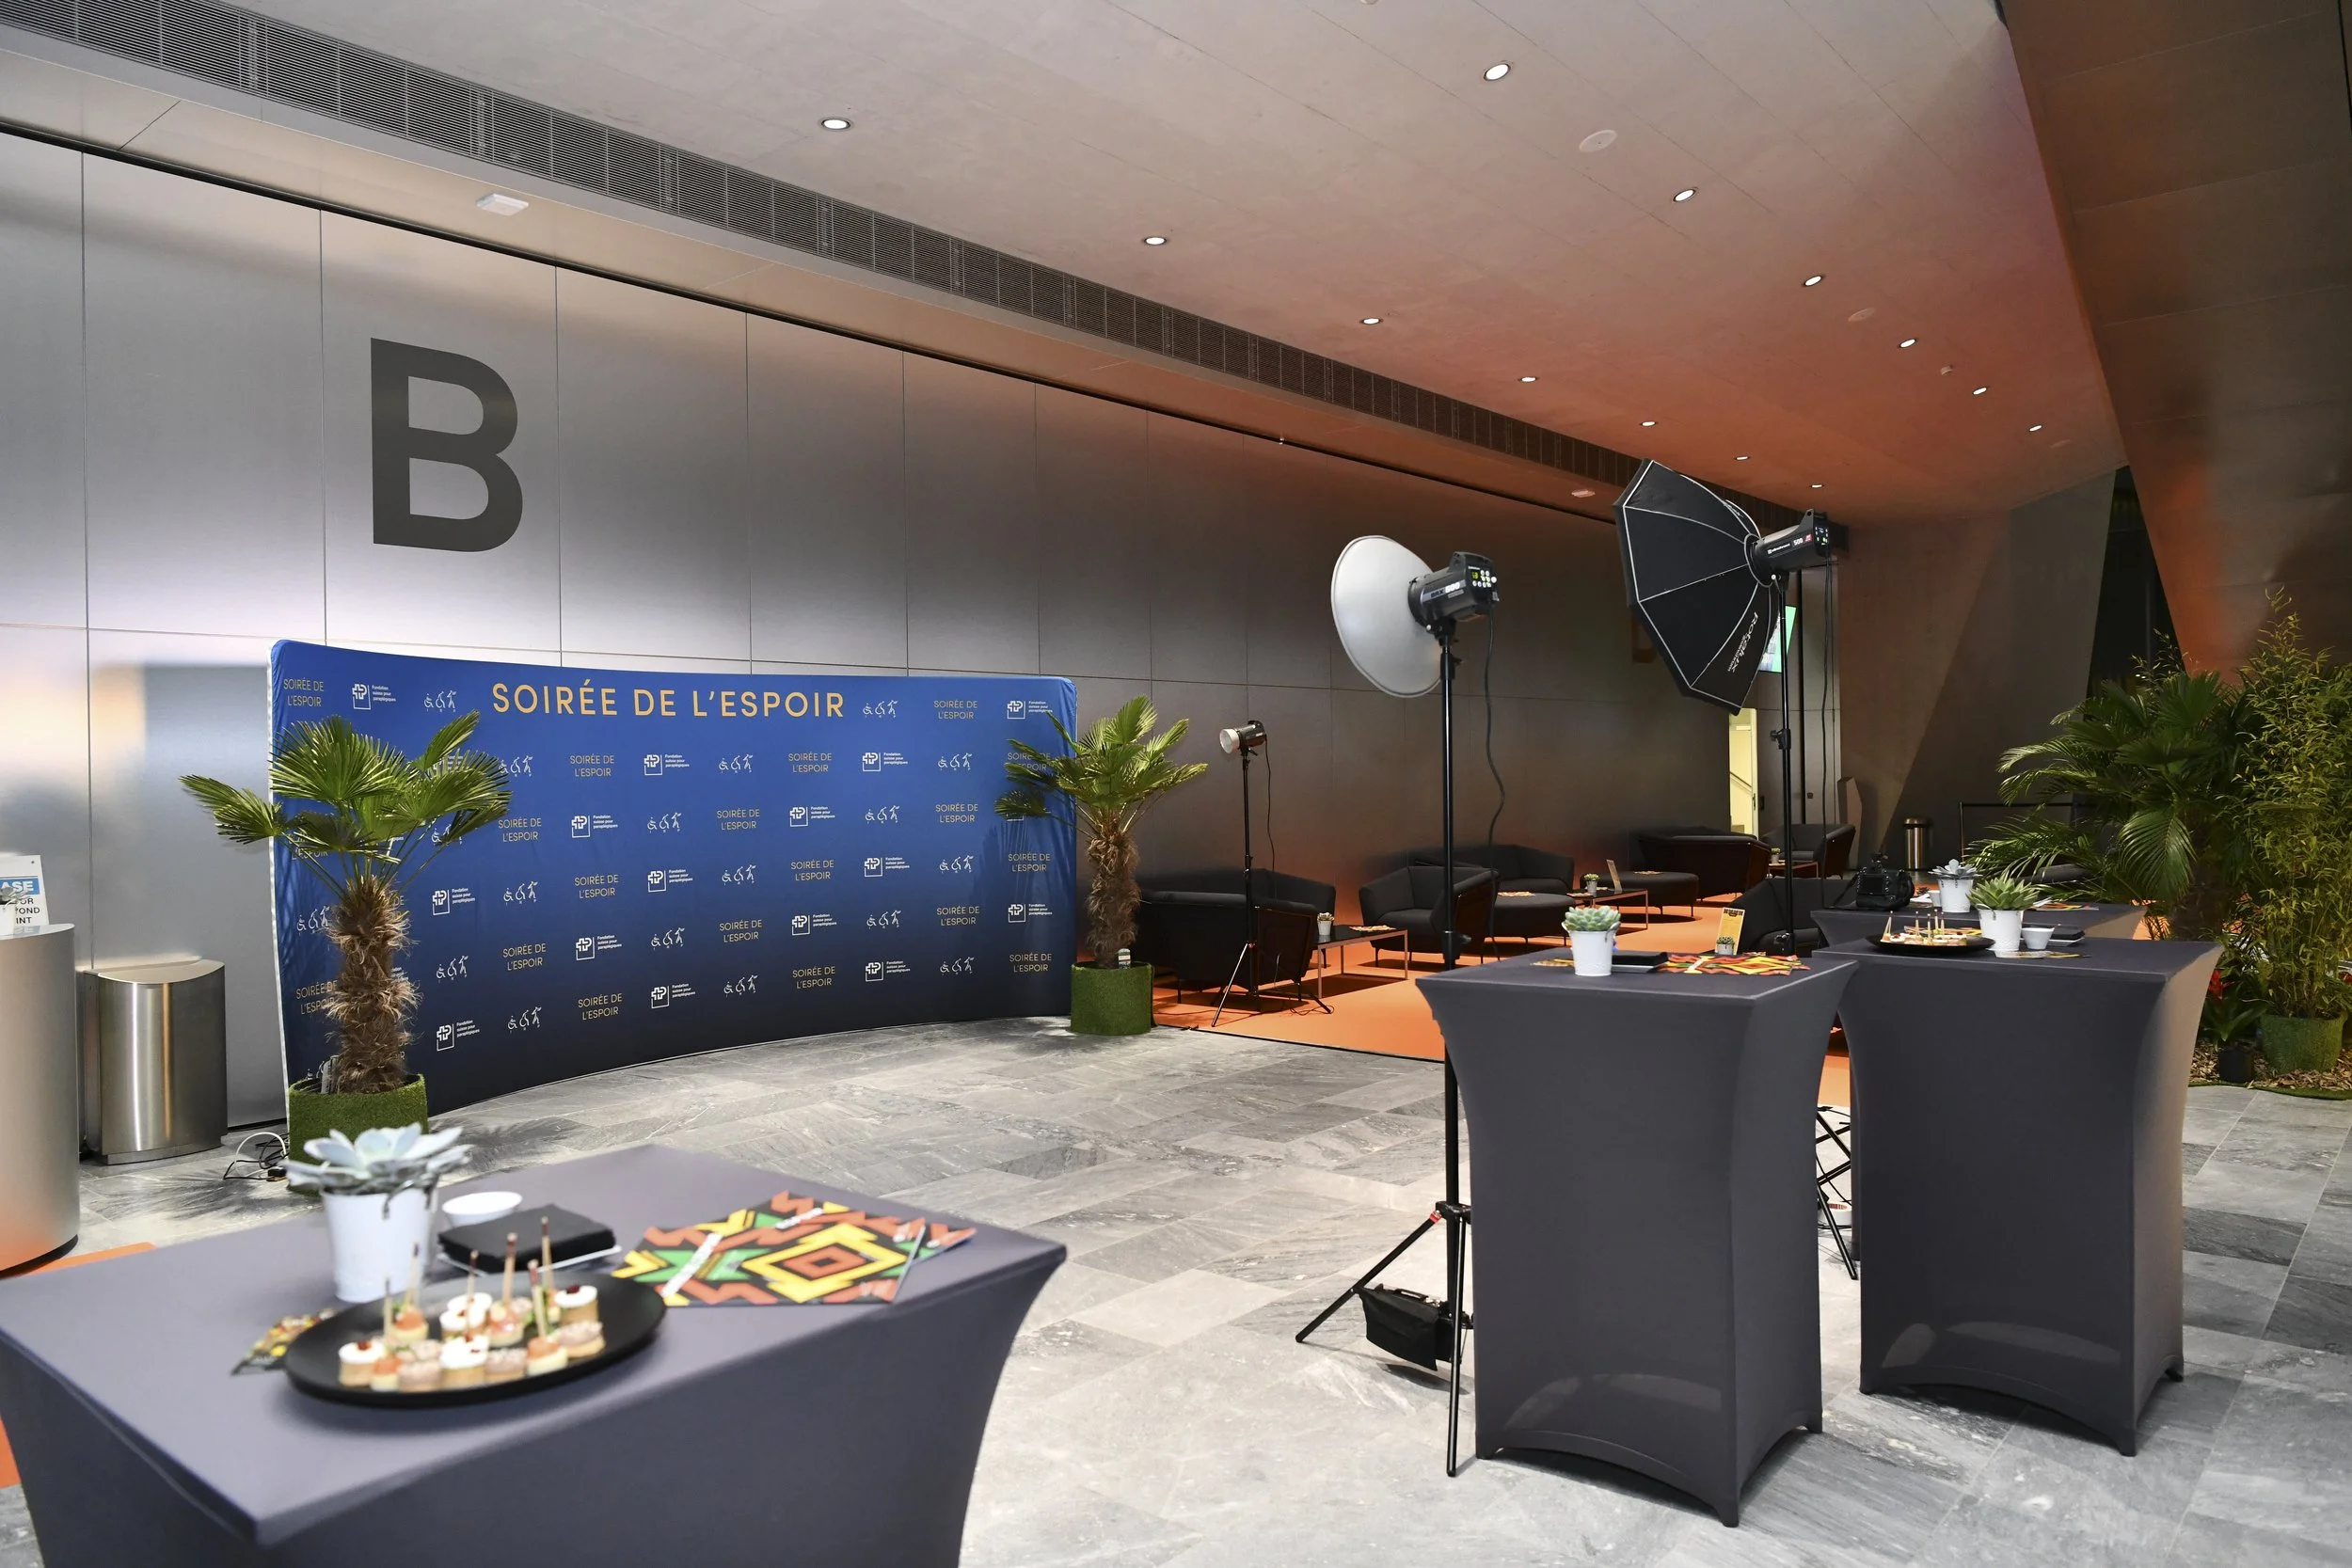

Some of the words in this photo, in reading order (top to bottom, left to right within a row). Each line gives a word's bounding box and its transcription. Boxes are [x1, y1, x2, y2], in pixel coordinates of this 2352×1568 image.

[371, 338, 522, 552] B
[284, 677, 310, 690] SOIRÉE
[313, 681, 324, 691] DE
[288, 696, 321, 706] L'ESPOIR
[492, 679, 617, 716] SOIRÉE
[634, 689, 675, 716] DE
[693, 690, 844, 717] L'ESPOIR
[934, 700, 963, 708] SOIRÉE
[570, 753, 600, 764] SOIRÉE
[603, 755, 614, 764] DE
[788, 752, 818, 761] SOIRÉE
[575, 768, 611, 777] L'ESPOIR
[935, 802, 965, 812] SOIRÉE
[717, 808, 746, 818] SOIRÉE
[749, 809, 760, 817] DE
[499, 816, 527, 829] SOIRÉE
[531, 818, 541, 827] DE
[722, 821, 756, 831] L'ESPOIR
[503, 832, 538, 843] L'ESPOIR
[1009, 852, 1037, 861] SOIRÉE
[791, 859, 820, 869] SOIRÉE
[823, 860, 834, 868] DE
[575, 873, 605, 886] SOIRÉE
[608, 875, 618, 883] DE
[795, 872, 831, 880] L'ESPOIR
[580, 888, 614, 898] L'ESPOIR
[937, 906, 965, 915] SOIRÉE
[720, 920, 749, 931] SOIRÉE
[941, 917, 976, 926] L'ESPOIR
[723, 932, 758, 942] L'ESPOIR
[503, 944, 532, 958] SOIRÉE
[535, 943, 546, 953] DE
[1009, 952, 1038, 962] SOIRÉE
[508, 957, 542, 971] L'ESPOIR
[792, 966, 821, 978] SOIRÉE
[824, 966, 835, 974] DE
[797, 978, 832, 989] L'ESPOIR
[296, 981, 324, 1000] SOIRÉE
[578, 994, 608, 1007] SOIRÉE
[612, 993, 623, 1003] DE
[582, 1006, 618, 1020] L'ESPOIR
